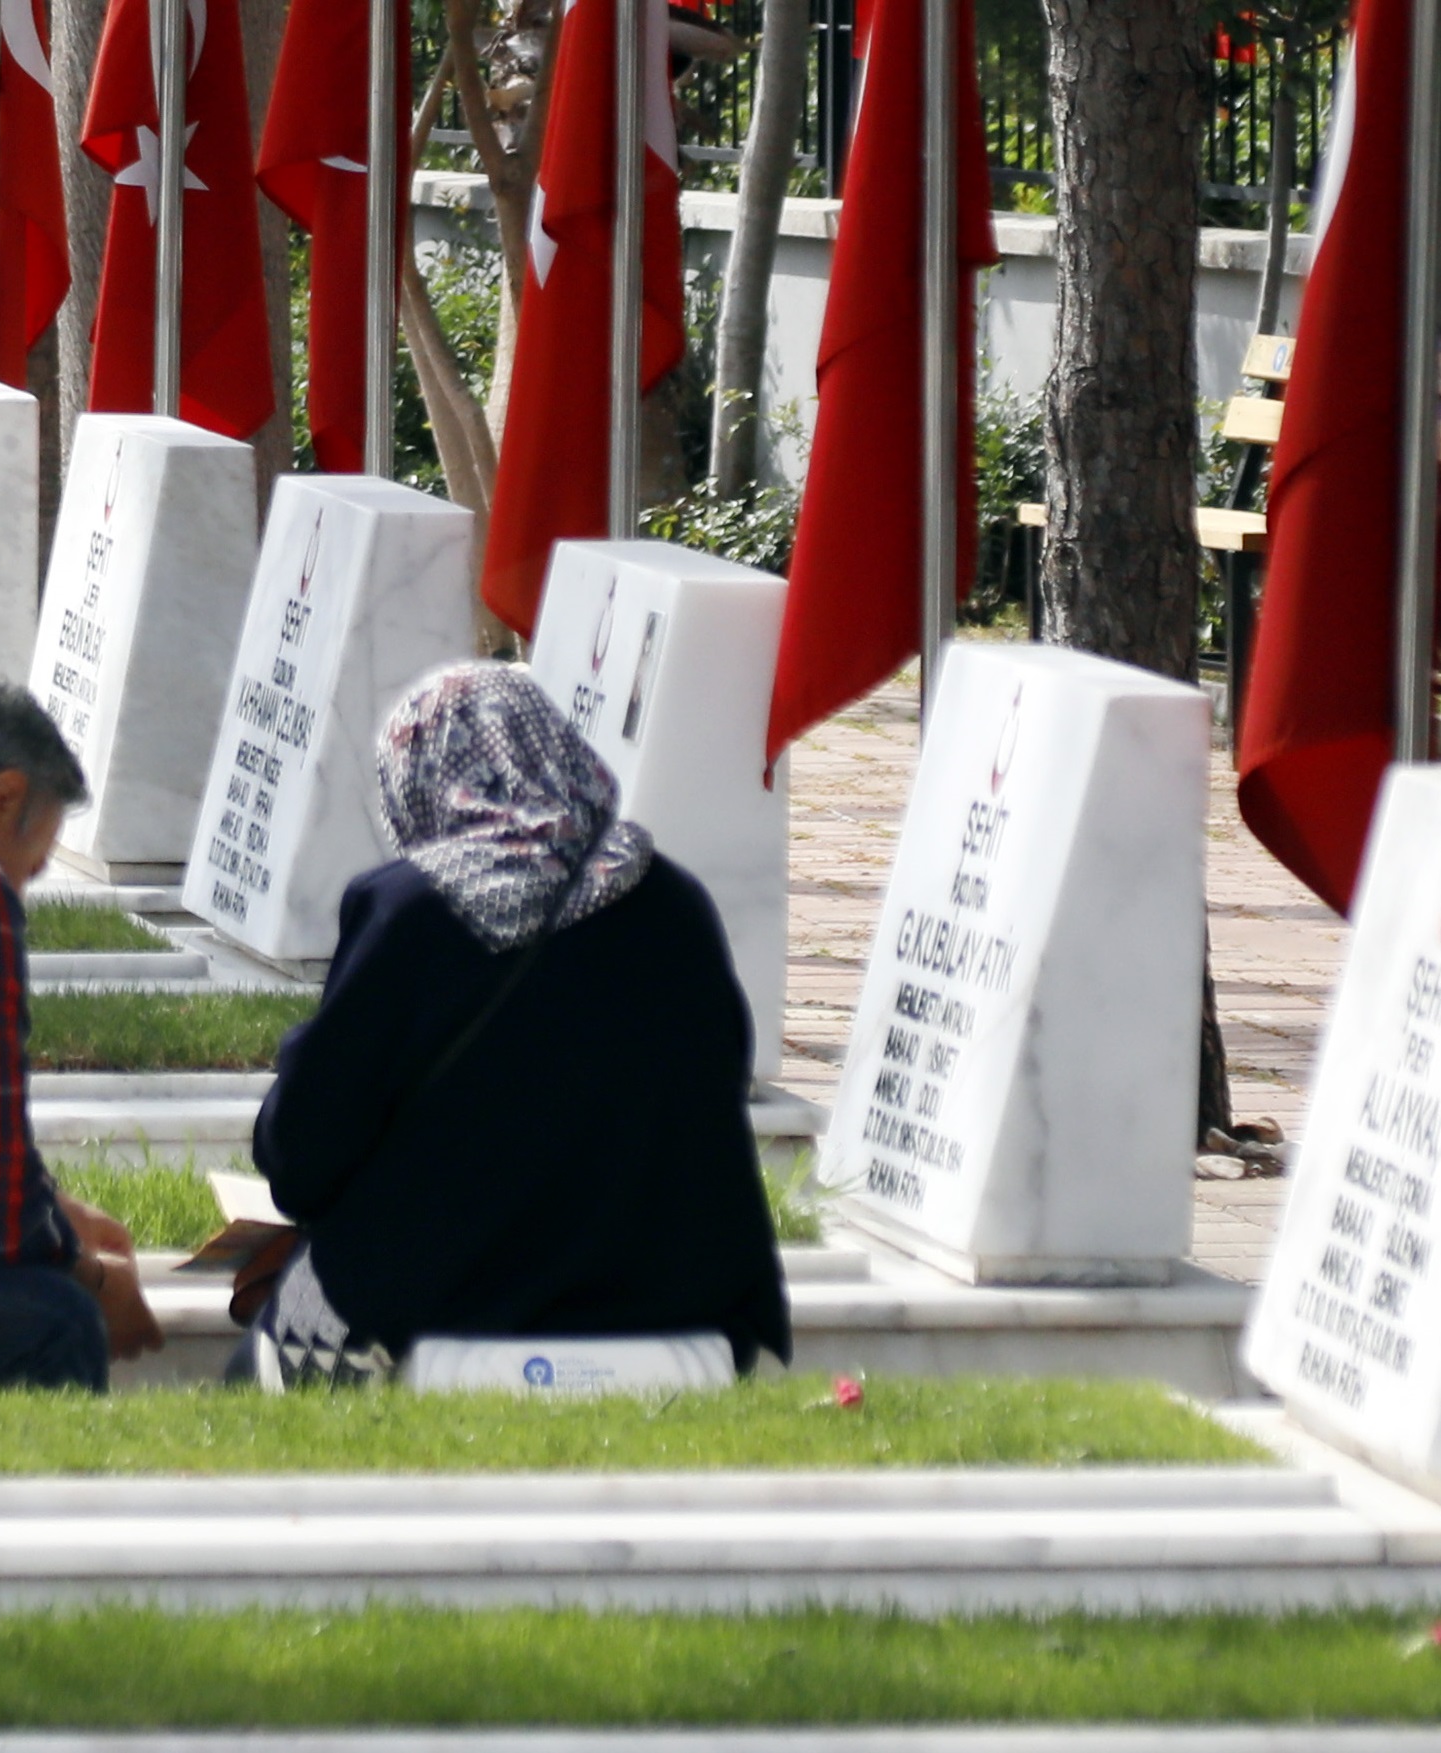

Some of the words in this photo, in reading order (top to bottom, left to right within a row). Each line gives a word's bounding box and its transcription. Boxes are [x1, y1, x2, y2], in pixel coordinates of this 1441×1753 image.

[279, 596, 312, 652] ŞEHİT
[959, 797, 1010, 863] ŞEHİT
[896, 907, 984, 982] G.KUBİLAY
[975, 924, 1020, 993] ATİK
[1404, 956, 1441, 1030] ŞEH
[1387, 1084, 1441, 1160] AYKA
